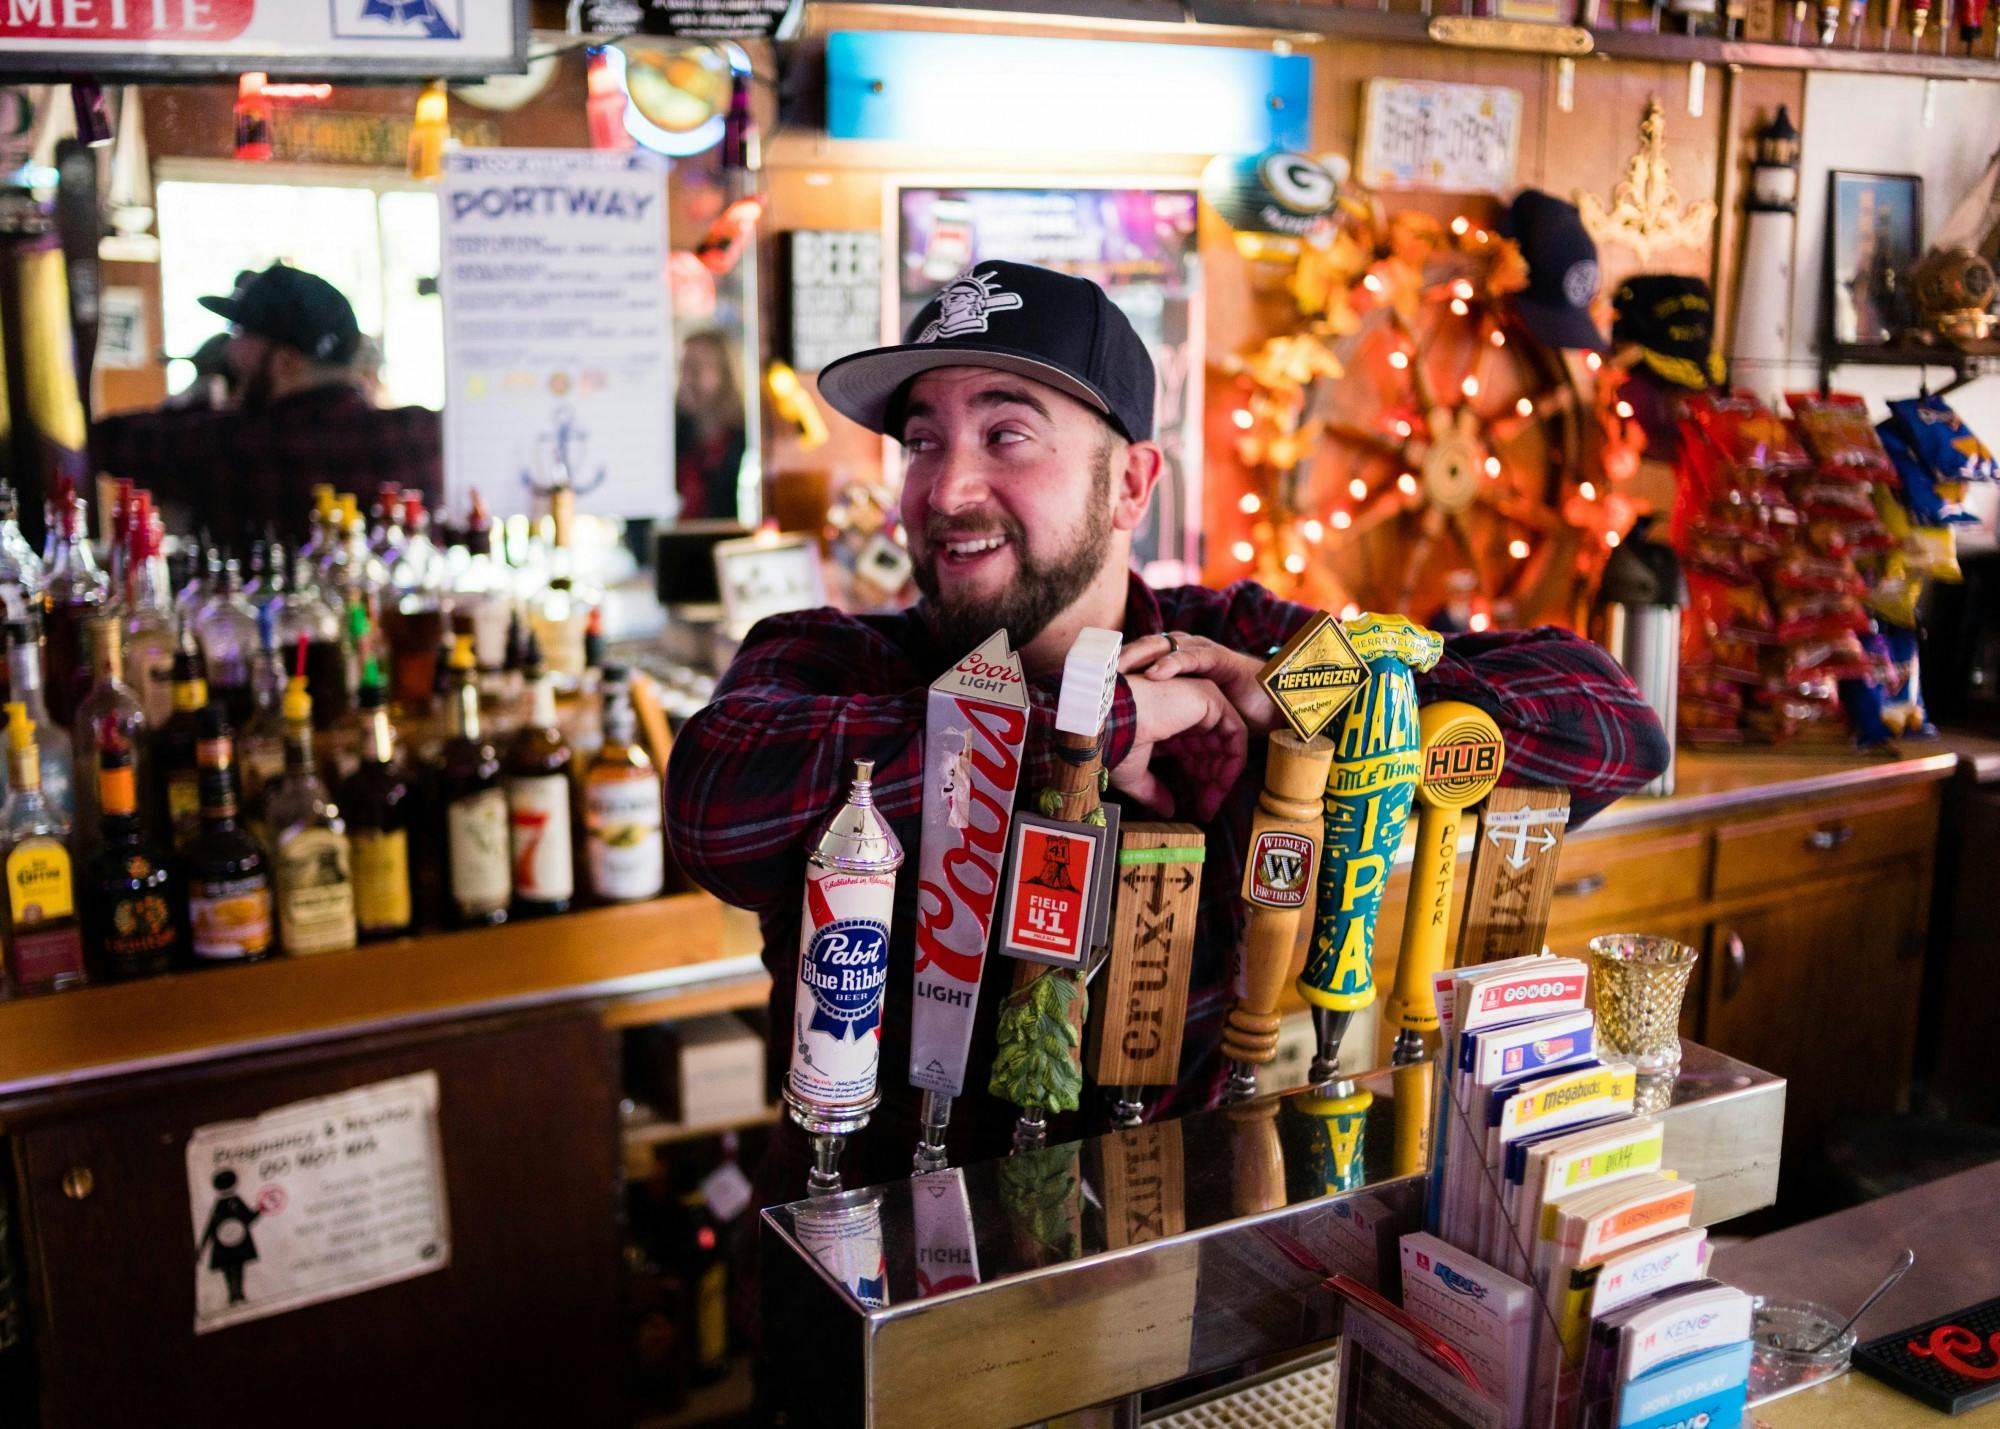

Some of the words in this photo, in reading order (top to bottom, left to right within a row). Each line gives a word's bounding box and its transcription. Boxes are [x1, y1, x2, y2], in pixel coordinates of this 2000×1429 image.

[0, 0, 217, 32] METTE
[452, 187, 654, 220] PORTWAY
[1391, 636, 1428, 654] NEVADA
[956, 653, 1022, 683] Coors
[1277, 669, 1360, 690] HEFEWEIZEN
[959, 675, 1008, 693] LIGHT
[1293, 703, 1314, 716] wheat
[1315, 699, 1333, 711] beer
[1338, 671, 1420, 760] HAZY
[1429, 746, 1496, 776] HUB
[1328, 764, 1379, 792] LITTLE
[512, 808, 550, 892] 7
[1049, 845, 1067, 860] 41
[1263, 837, 1308, 855] WIDMER
[1431, 824, 1455, 926] PORTER
[1029, 895, 1068, 913] FIELD
[1255, 884, 1302, 902] BROTHERS
[1027, 908, 1065, 934] 41
[1484, 864, 1536, 960] rux
[822, 933, 883, 966] Pabst
[803, 957, 838, 991] Blue
[840, 964, 888, 991] Ribbo
[835, 992, 868, 1001] BEER
[917, 981, 973, 1008] LIGHT
[1542, 1081, 1600, 1112] megabucks
[1631, 1256, 1673, 1282] KENO
[1664, 1313, 1711, 1341] KENO
[1696, 1374, 1728, 1392] PLAY
